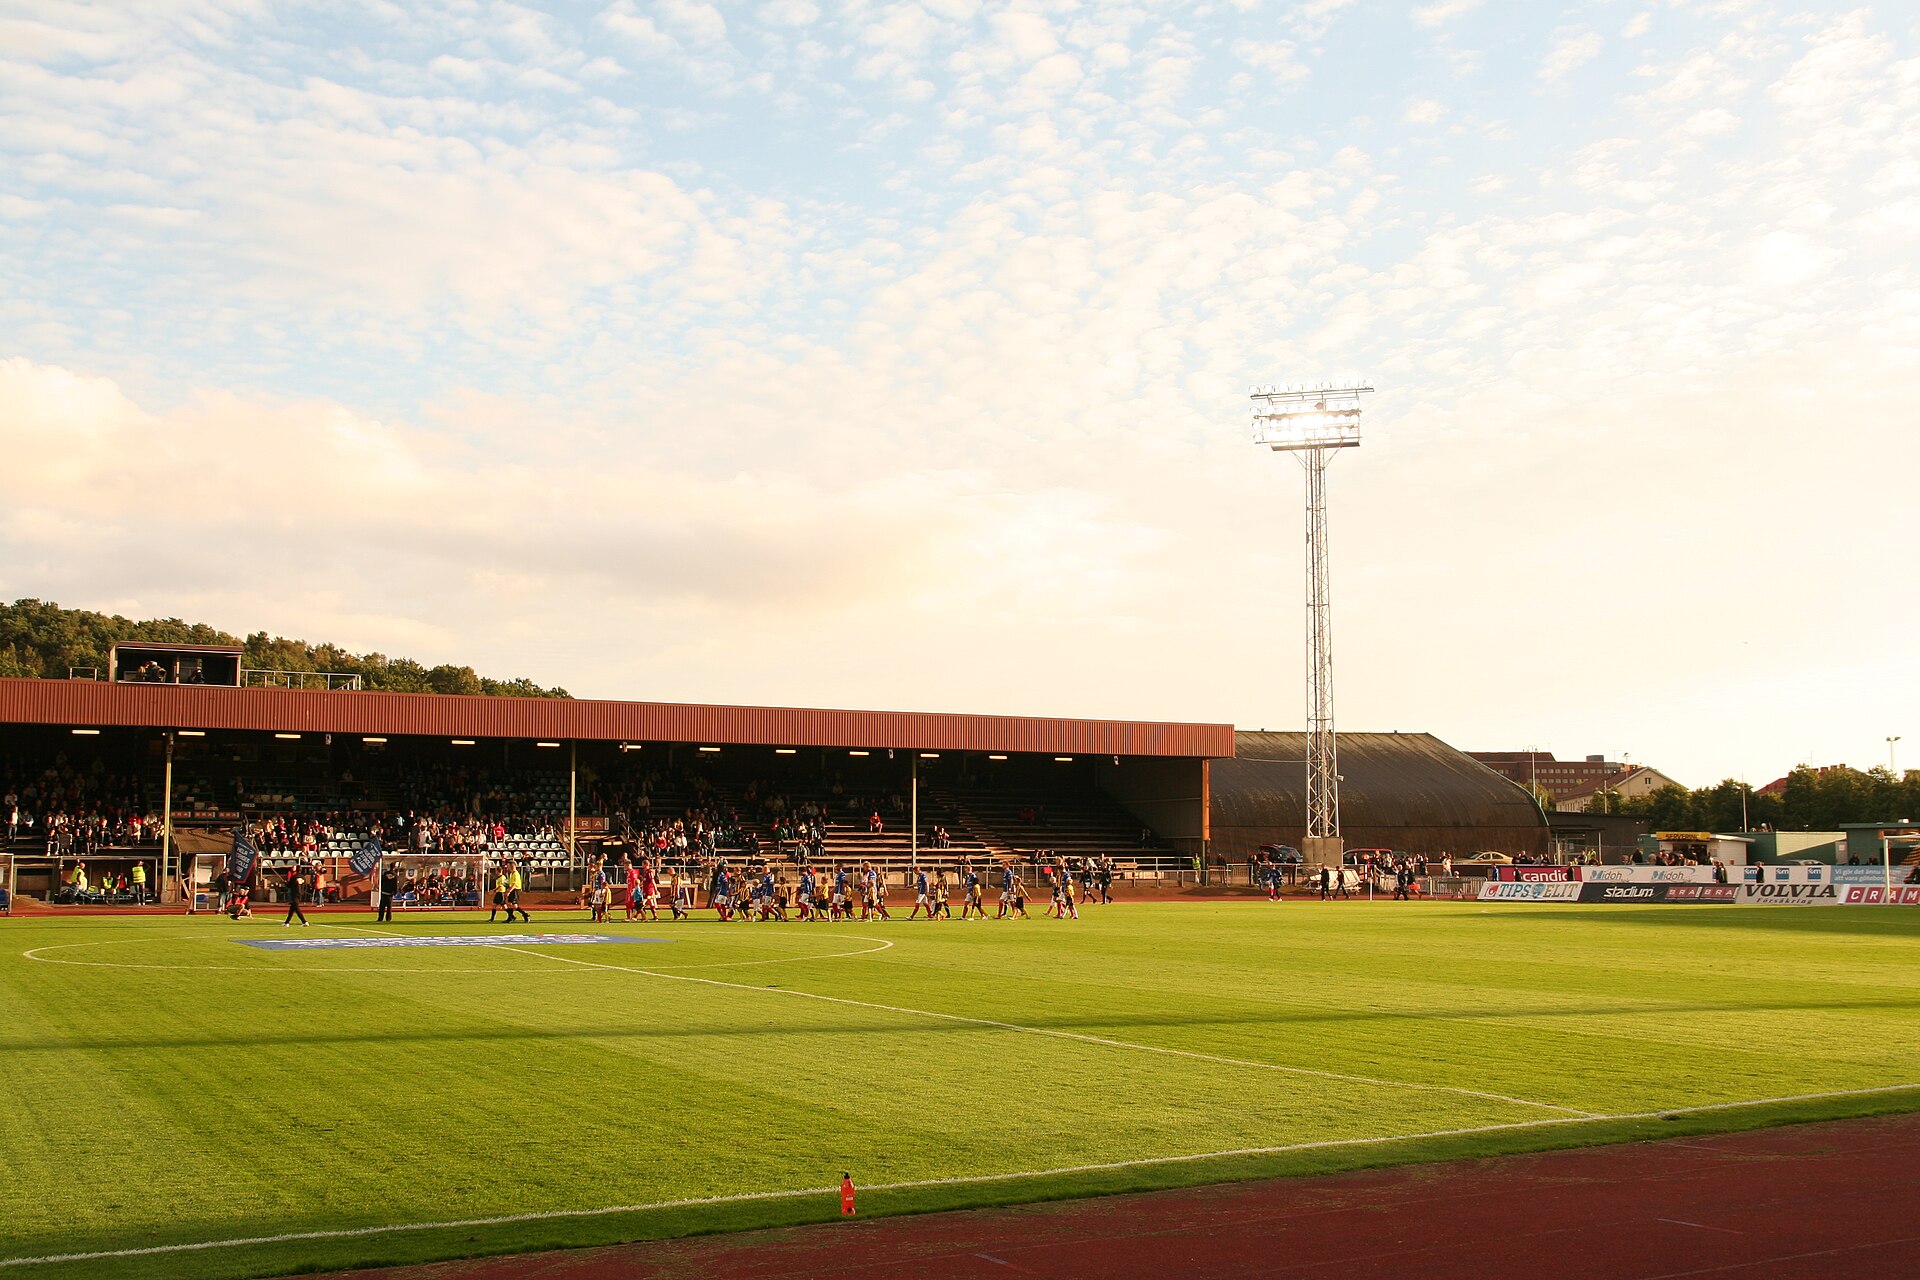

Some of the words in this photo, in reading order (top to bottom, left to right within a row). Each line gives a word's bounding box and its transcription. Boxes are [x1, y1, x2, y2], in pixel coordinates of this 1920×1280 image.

[1498, 884, 1531, 898] TIPS
[1542, 884, 1578, 898] ELIT
[1603, 886, 1653, 897] stadium
[1744, 884, 1837, 898] VOLVIA
